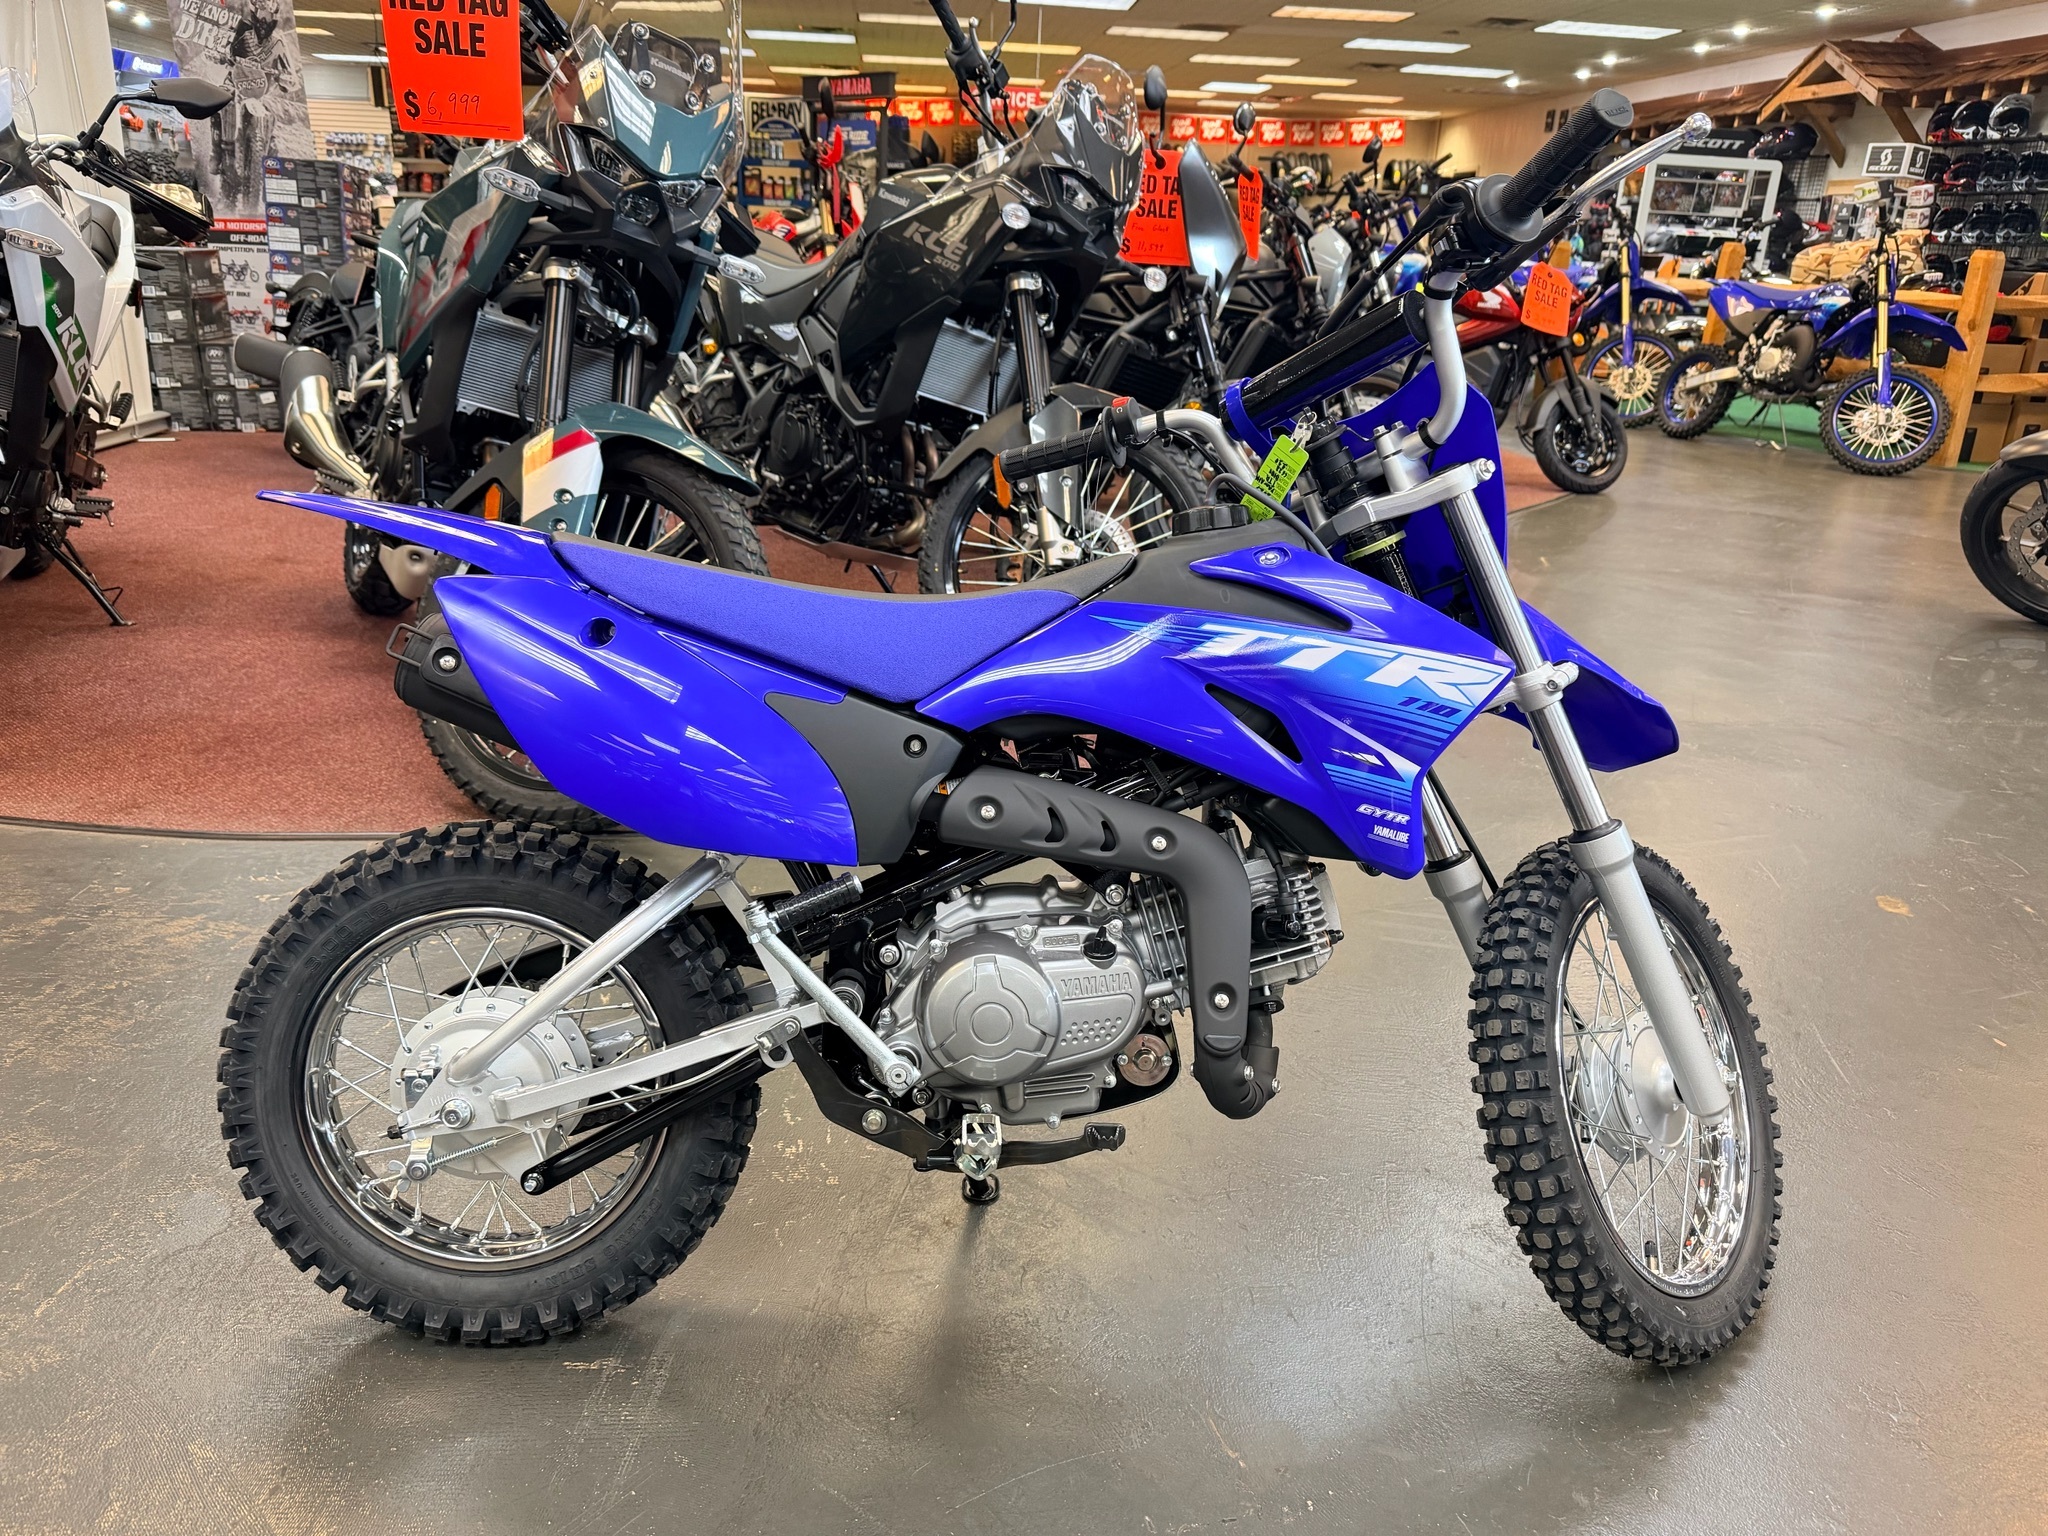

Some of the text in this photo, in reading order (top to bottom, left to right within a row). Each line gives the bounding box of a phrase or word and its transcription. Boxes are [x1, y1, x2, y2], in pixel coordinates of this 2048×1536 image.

[200, 4, 242, 28] KNOW
[176, 14, 238, 52] DIRT
[414, 18, 486, 57] SALE
[831, 77, 871, 95] YAMAHA
[404, 89, 480, 120] $ 6,999
[1684, 137, 1744, 150] SCOTT
[1239, 184, 1260, 205] RED TAG
[1135, 198, 1177, 219] SALE
[1243, 205, 1255, 222] SALE
[903, 221, 968, 262] KLE
[933, 255, 961, 272] 500
[1531, 273, 1567, 298] RED TAG
[1535, 290, 1558, 308] SALE
[51, 303, 63, 318] 500
[1194, 622, 1501, 707] TTR
[1397, 697, 1463, 718] 110
[1356, 803, 1411, 825] GYTR
[1373, 824, 1410, 844] YAMALUBE
[1061, 971, 1133, 999] YAMAHA
